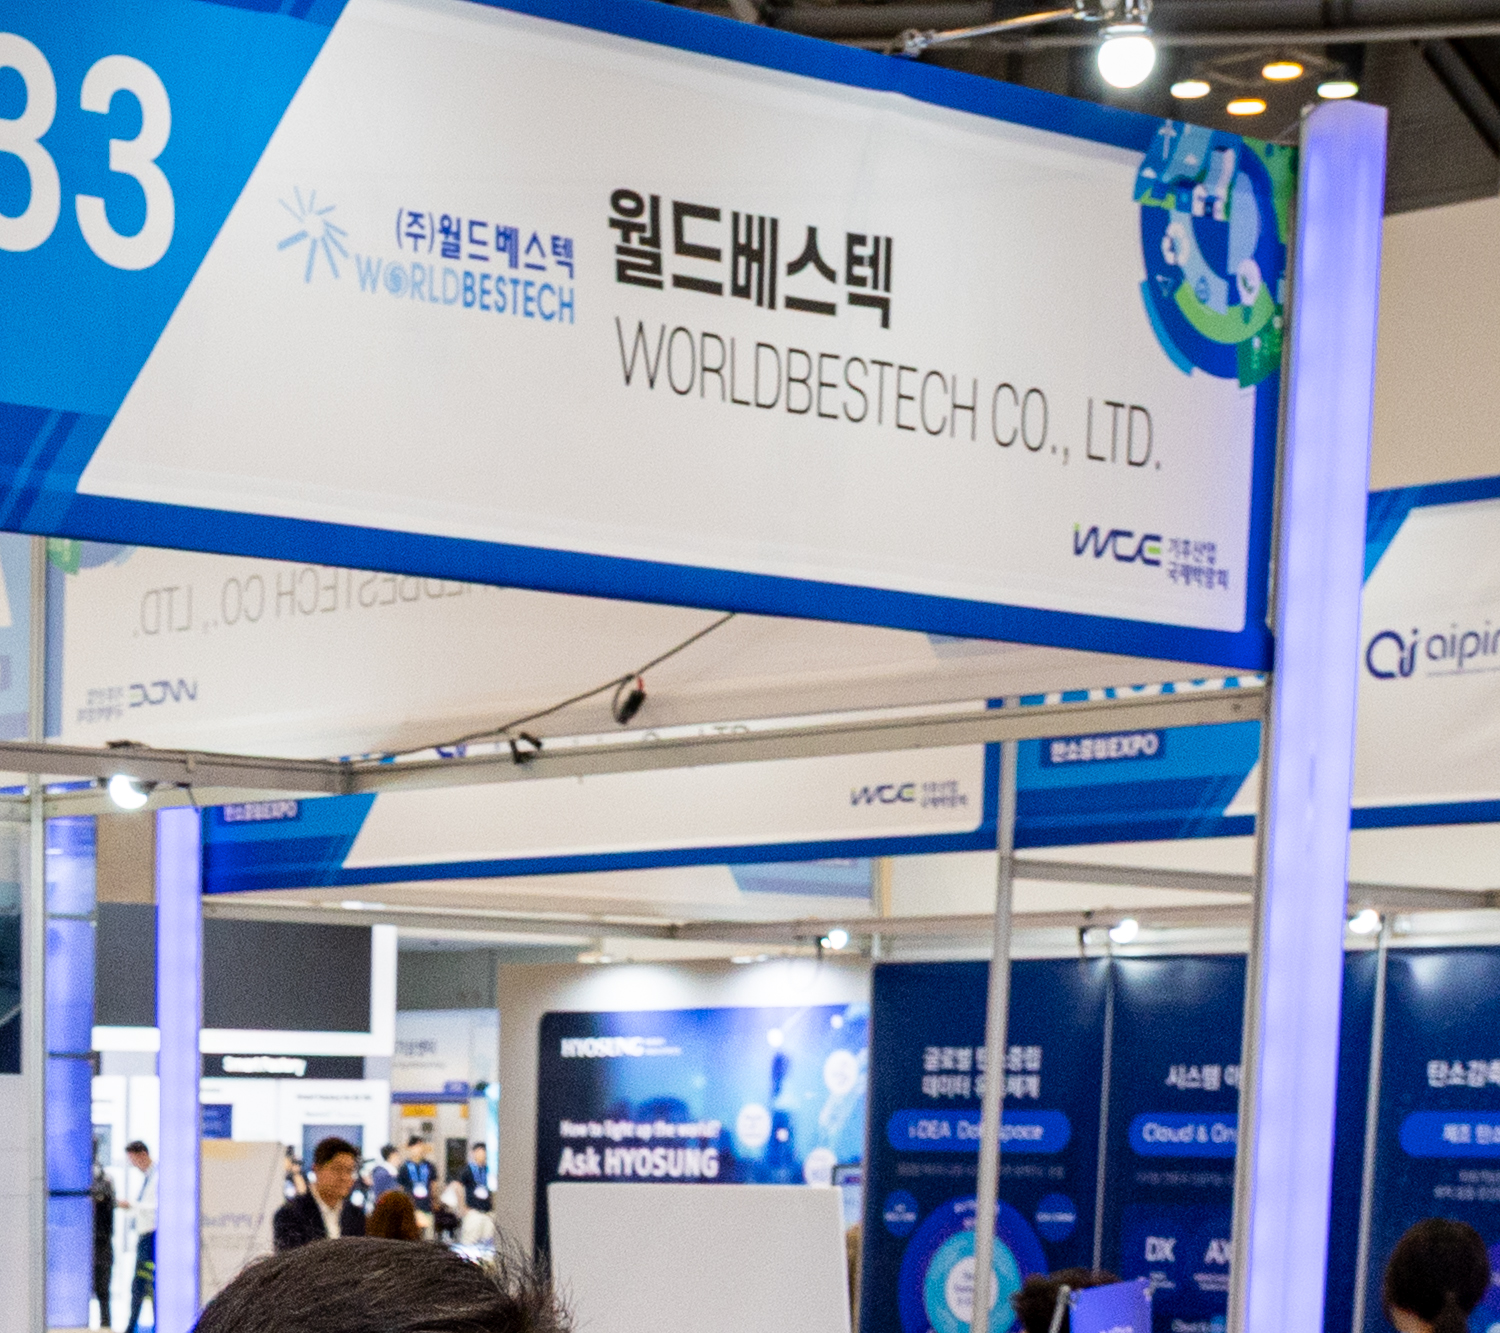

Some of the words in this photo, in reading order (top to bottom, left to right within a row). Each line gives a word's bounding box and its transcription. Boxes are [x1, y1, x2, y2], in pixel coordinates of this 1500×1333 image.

[397, 206, 575, 279] (주)월드베스텍
[607, 188, 893, 328] 월드베스텍
[356, 252, 575, 324] WORLDBESTECH
[616, 317, 977, 441] WORLDBESTECH
[992, 382, 1069, 466] CO.,
[1085, 396, 1161, 471] LTD.
[1168, 538, 1218, 564] 기후산업
[1167, 561, 1230, 591] 국제박람회
[560, 1120, 587, 1138] How
[558, 1147, 601, 1176] Ask
[605, 1147, 720, 1178] HYOSUNG
[1145, 1235, 1176, 1262] DX
